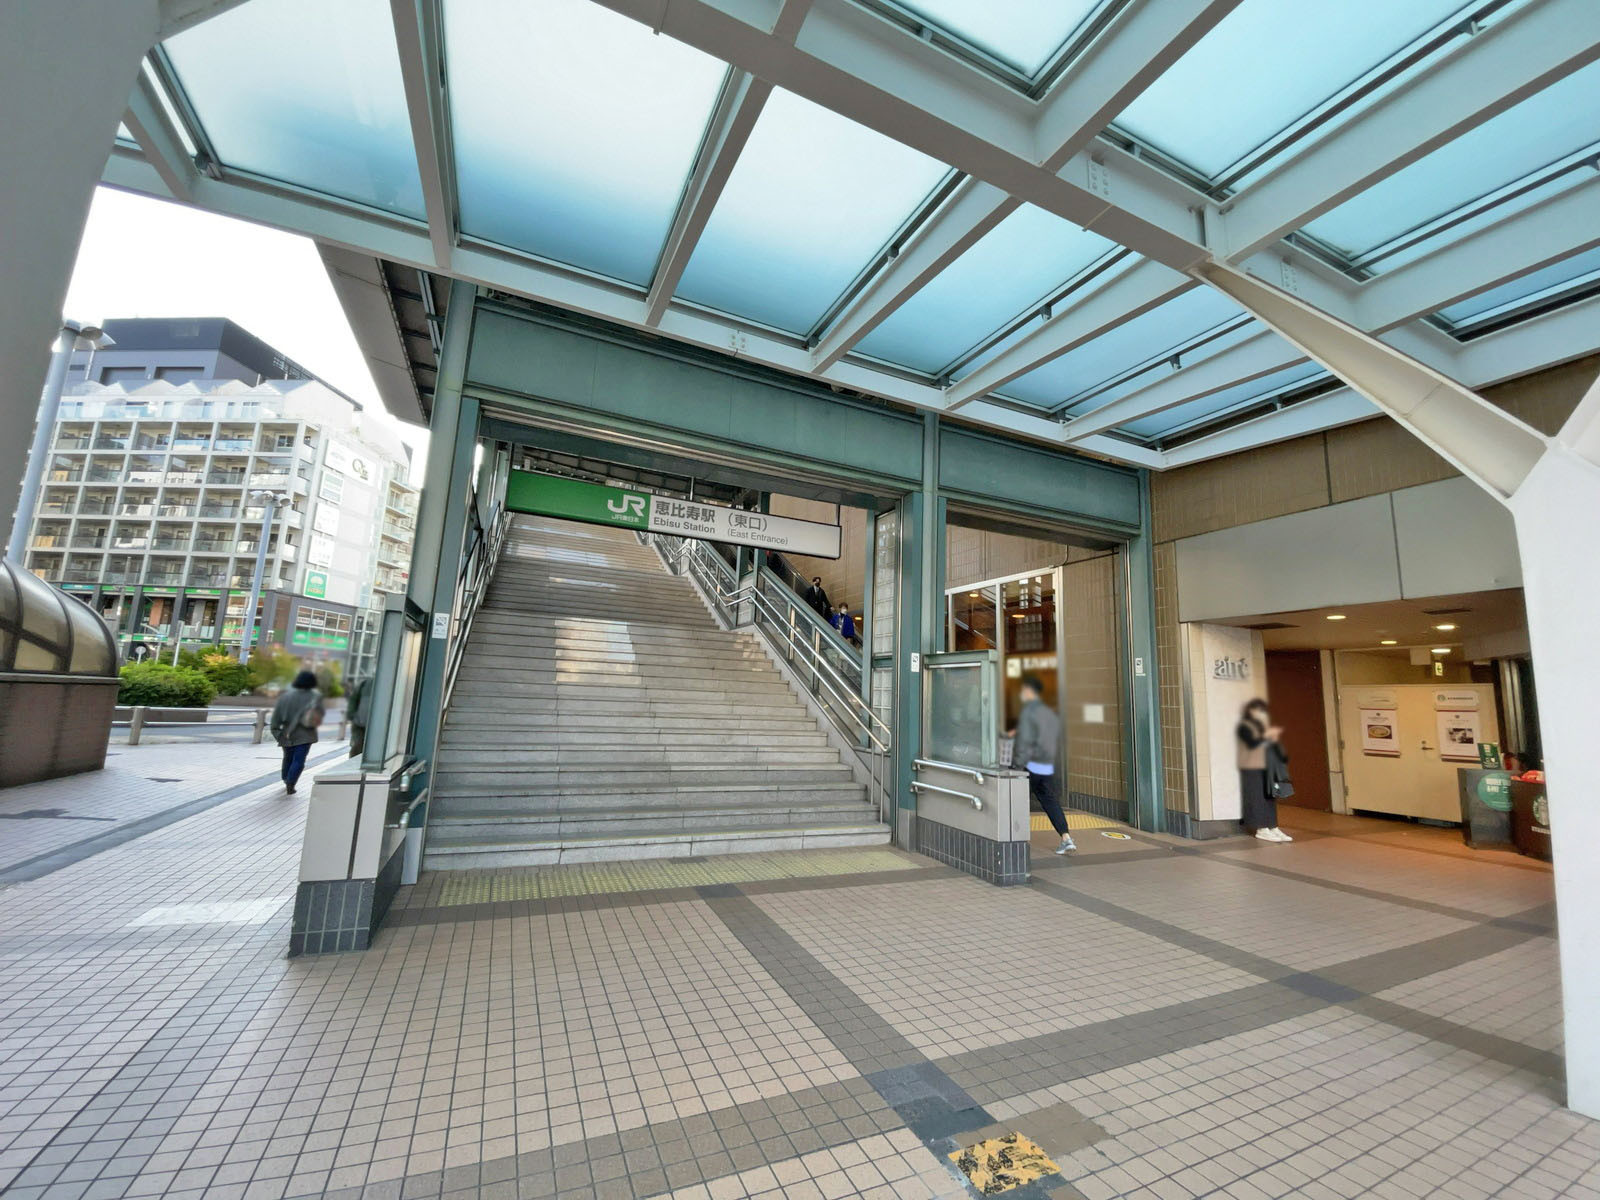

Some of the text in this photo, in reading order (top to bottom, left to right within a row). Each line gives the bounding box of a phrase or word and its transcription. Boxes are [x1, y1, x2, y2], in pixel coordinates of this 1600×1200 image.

[607, 494, 646, 517] JR
[655, 500, 768, 532] 恵比寿駅 （東口）
[653, 516, 789, 545] Ebisu Station (East Entrance)
